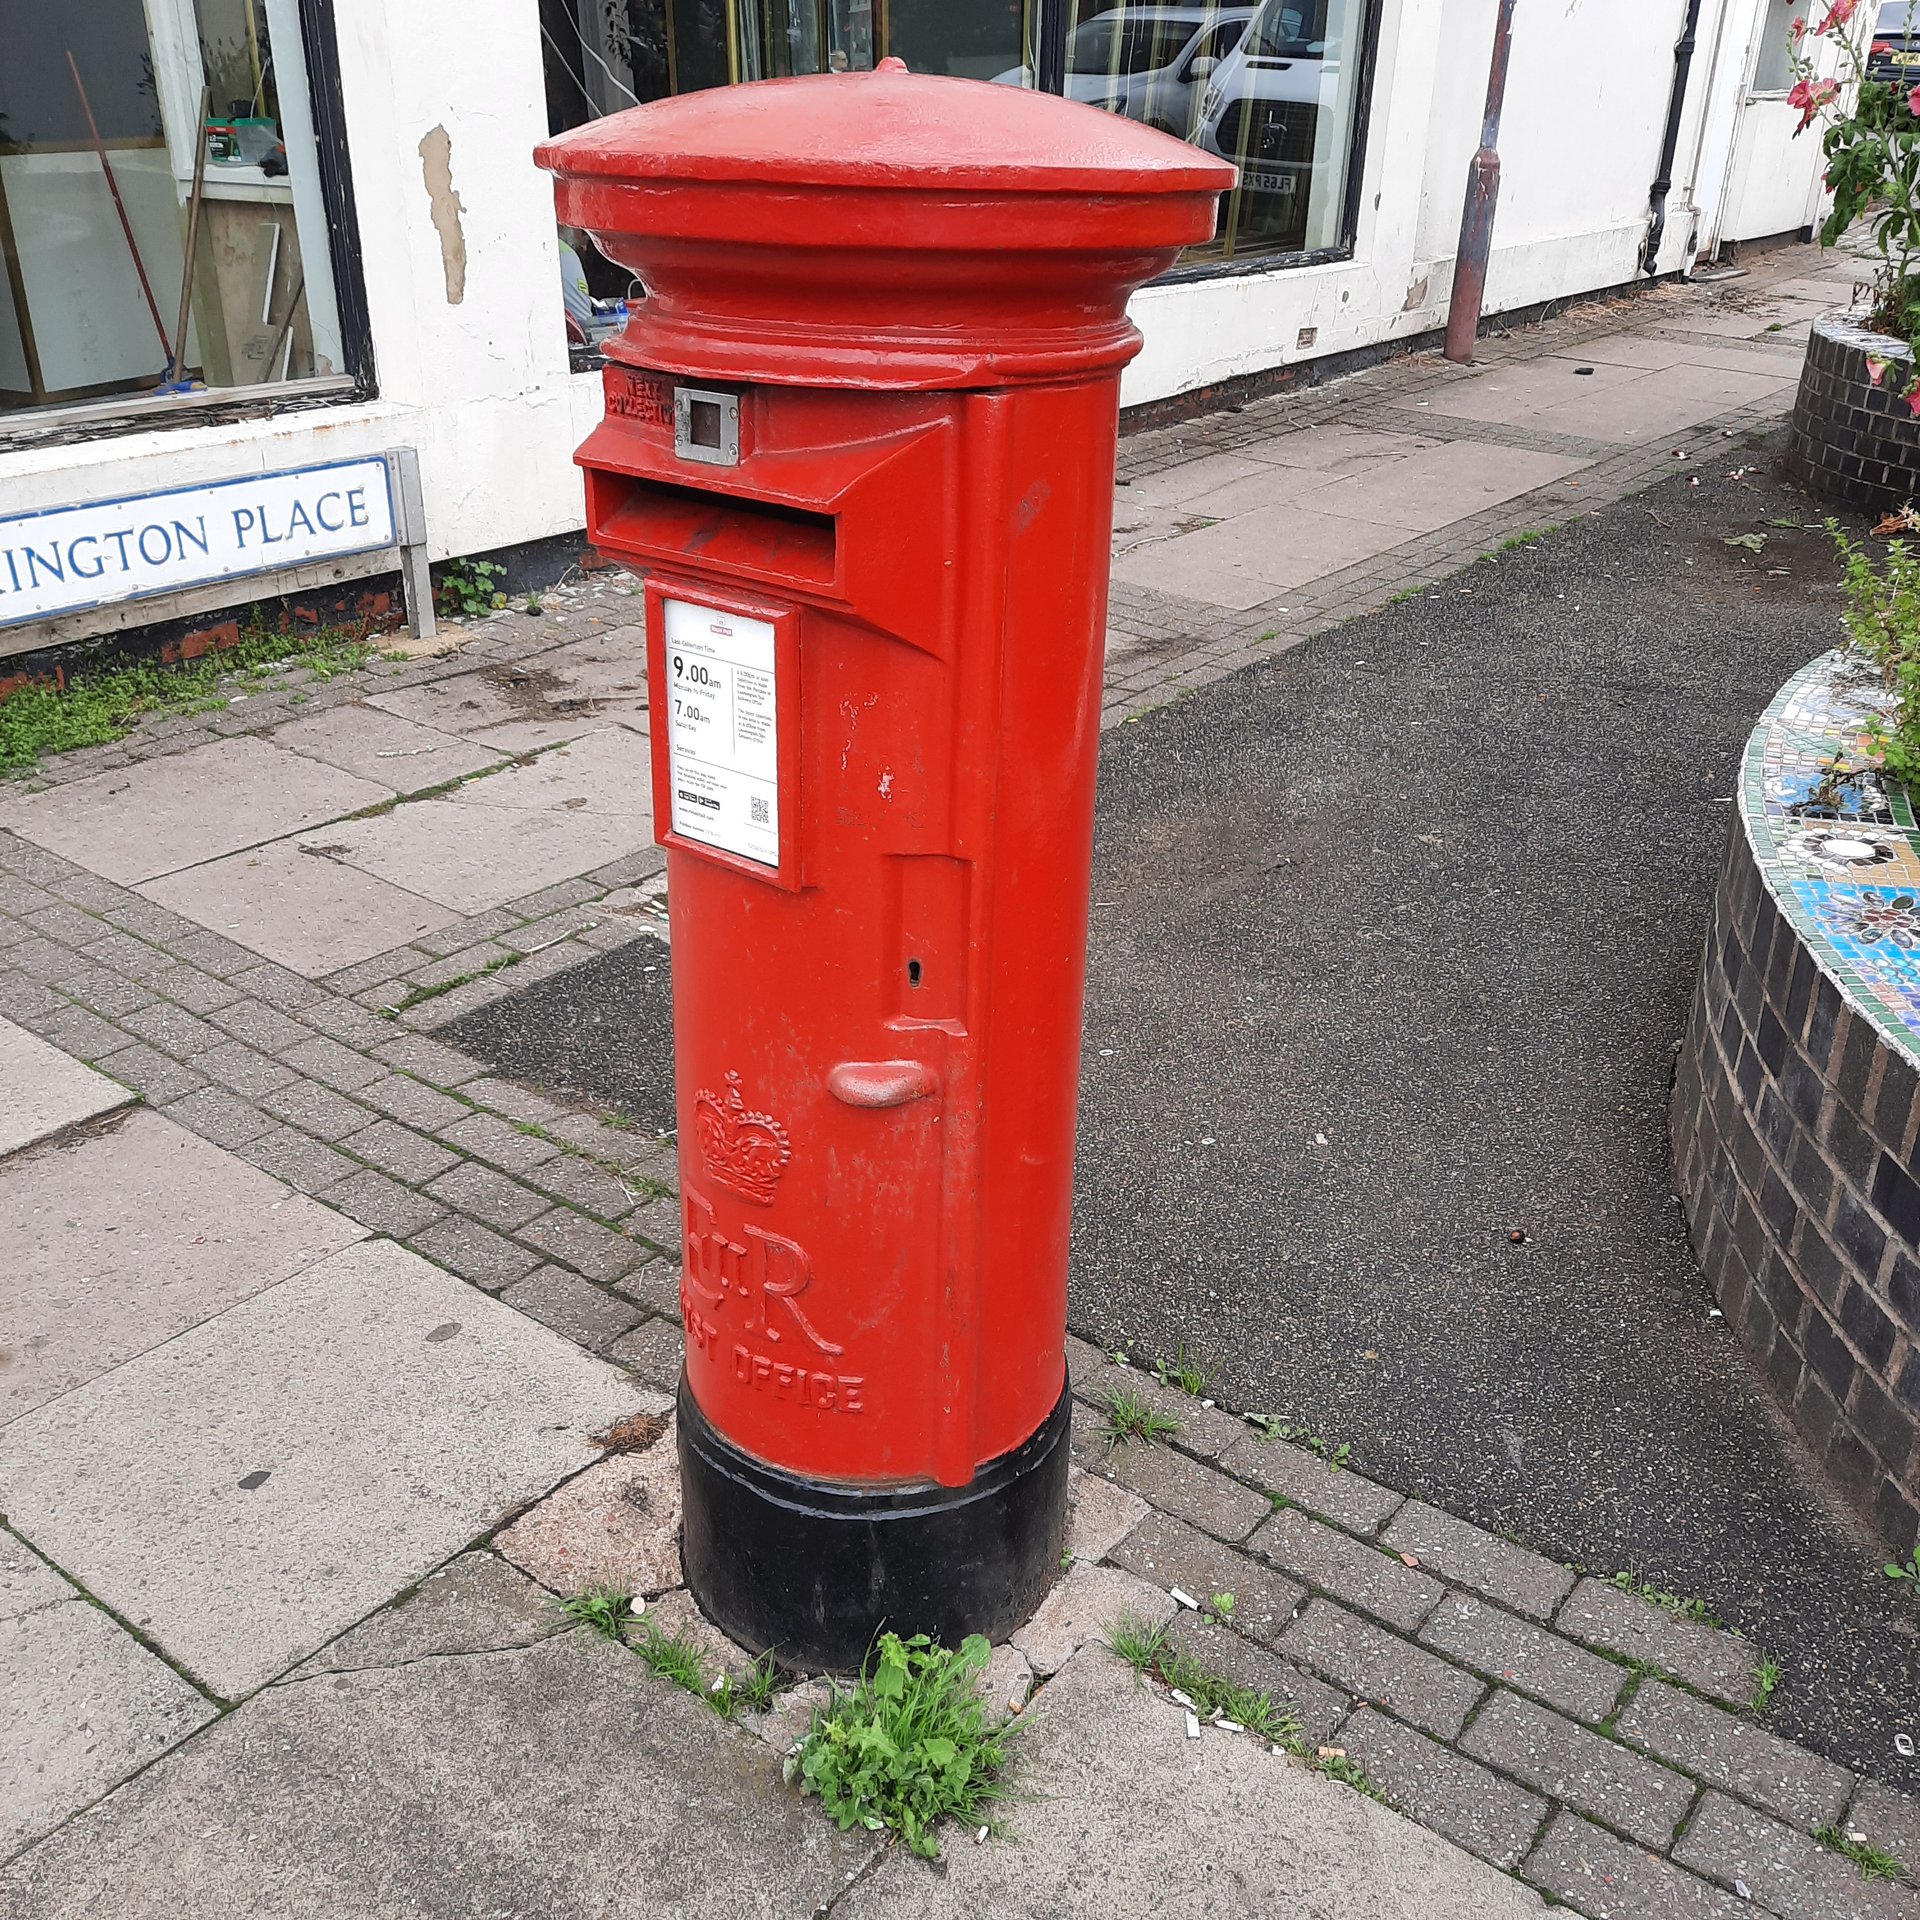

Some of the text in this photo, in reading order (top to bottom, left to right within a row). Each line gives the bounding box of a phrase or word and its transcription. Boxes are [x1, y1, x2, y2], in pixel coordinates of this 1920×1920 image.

[0, 487, 370, 594] INGTON PLACE
[699, 688, 716, 701] Friday
[680, 1279, 865, 1414] OST OFFICE
